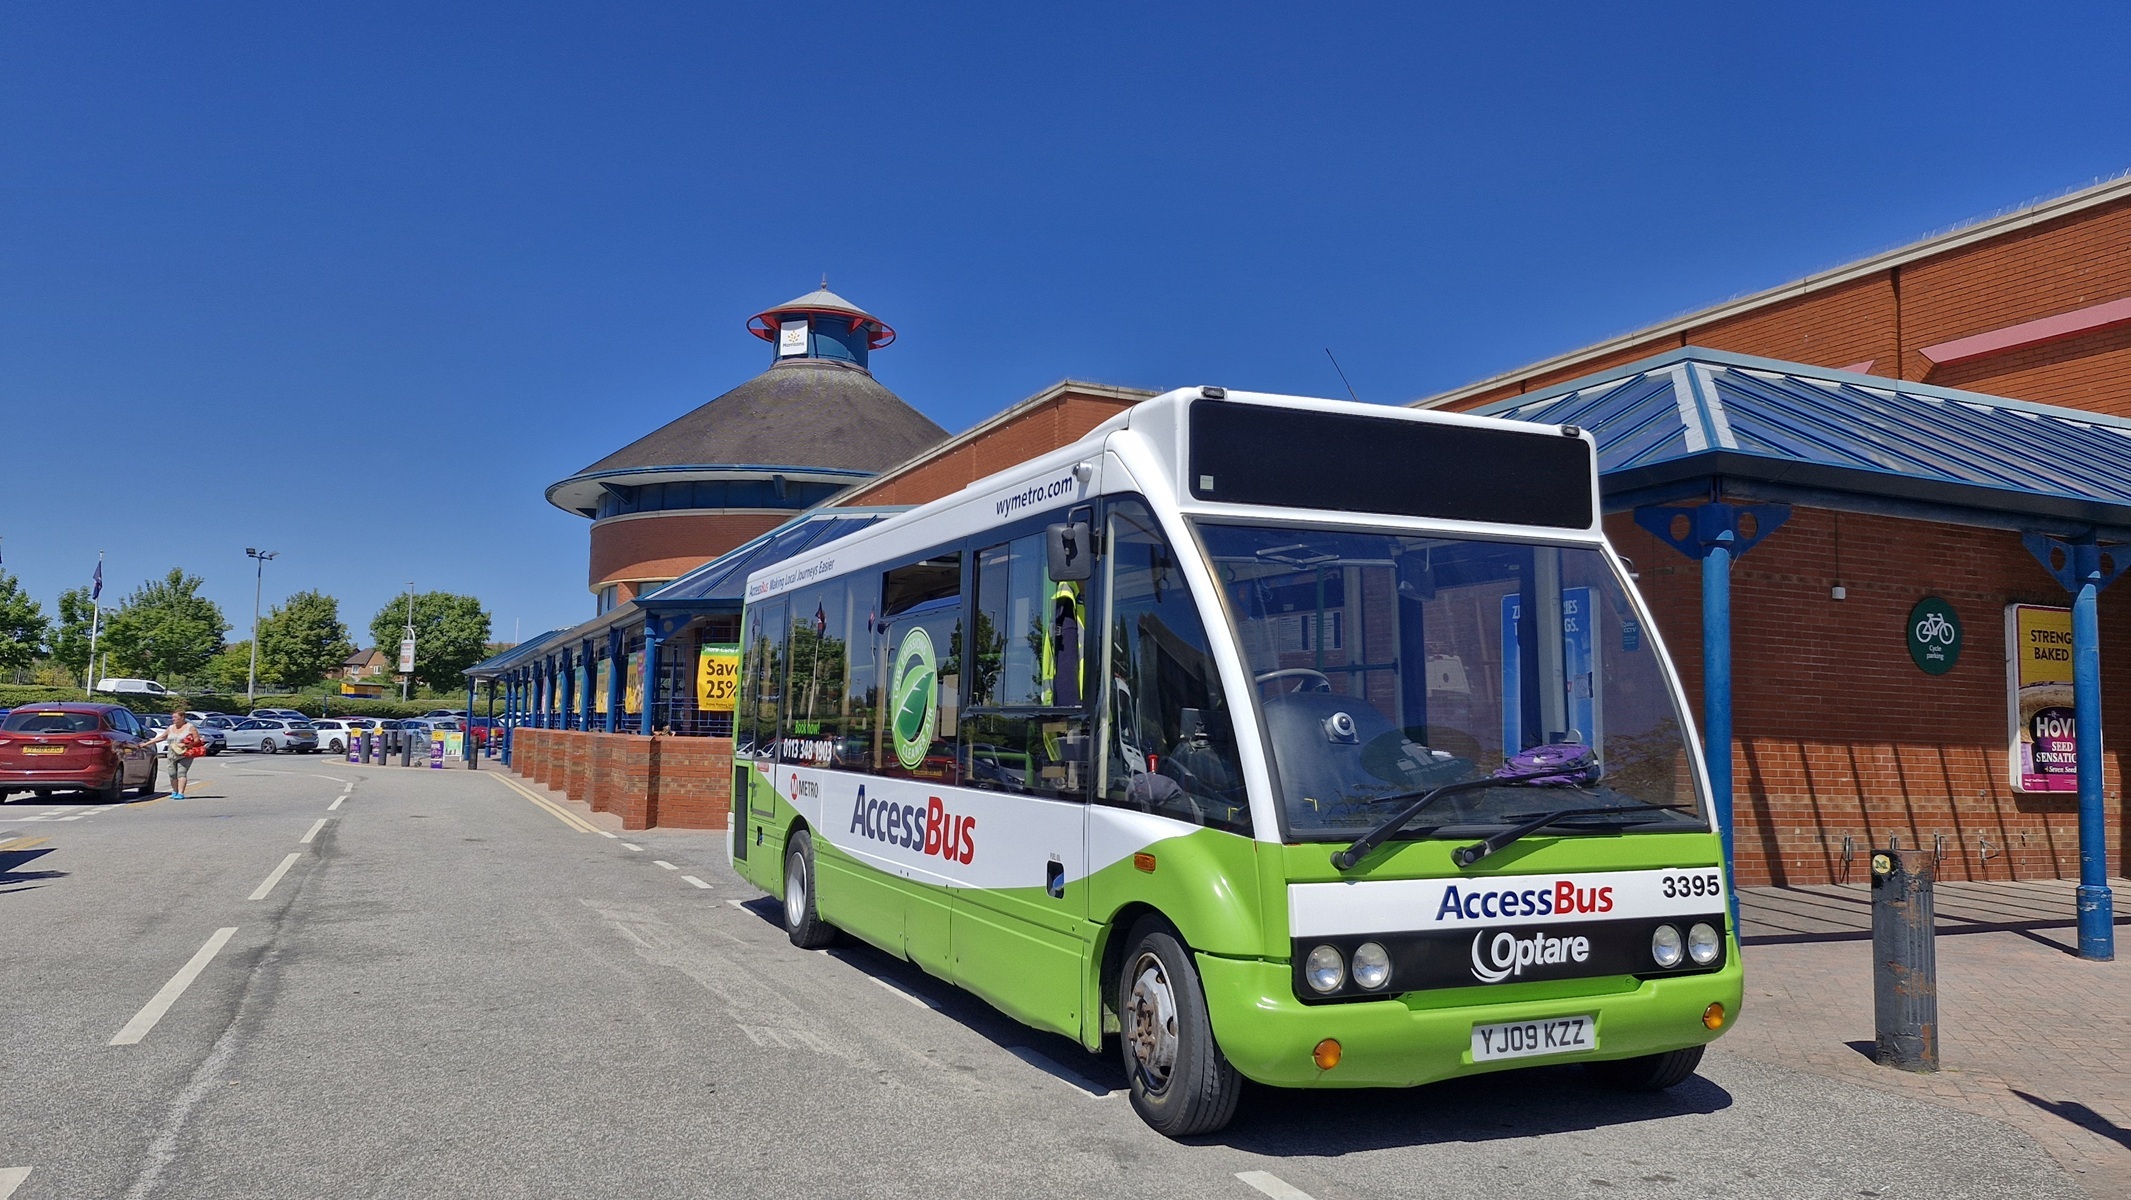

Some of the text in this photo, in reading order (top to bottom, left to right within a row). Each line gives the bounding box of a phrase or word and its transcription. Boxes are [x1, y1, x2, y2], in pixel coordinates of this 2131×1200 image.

[996, 476, 1073, 518] wymetro.com
[770, 576, 785, 590] Making
[785, 569, 798, 586] Local
[797, 564, 819, 581] Journeys
[819, 557, 836, 574] Easier
[1929, 645, 1942, 653] Cycle
[2030, 629, 2073, 645] STRENG
[900, 639, 928, 665] EMISSIONS
[1926, 653, 1944, 661] parking
[2034, 647, 2069, 662] BAKED
[902, 736, 927, 760] CLEANER
[925, 706, 934, 734] AIR
[2036, 717, 2076, 739] HOVI
[783, 738, 833, 762] 0113 348 1903
[2051, 741, 2074, 752] SEED
[799, 780, 819, 799] METRO
[850, 784, 976, 866] AccessBus
[1435, 875, 1720, 921] AccessBus 3395
[1489, 931, 1590, 977] Optare
[1481, 1019, 1586, 1055] YJ09 KZZ
